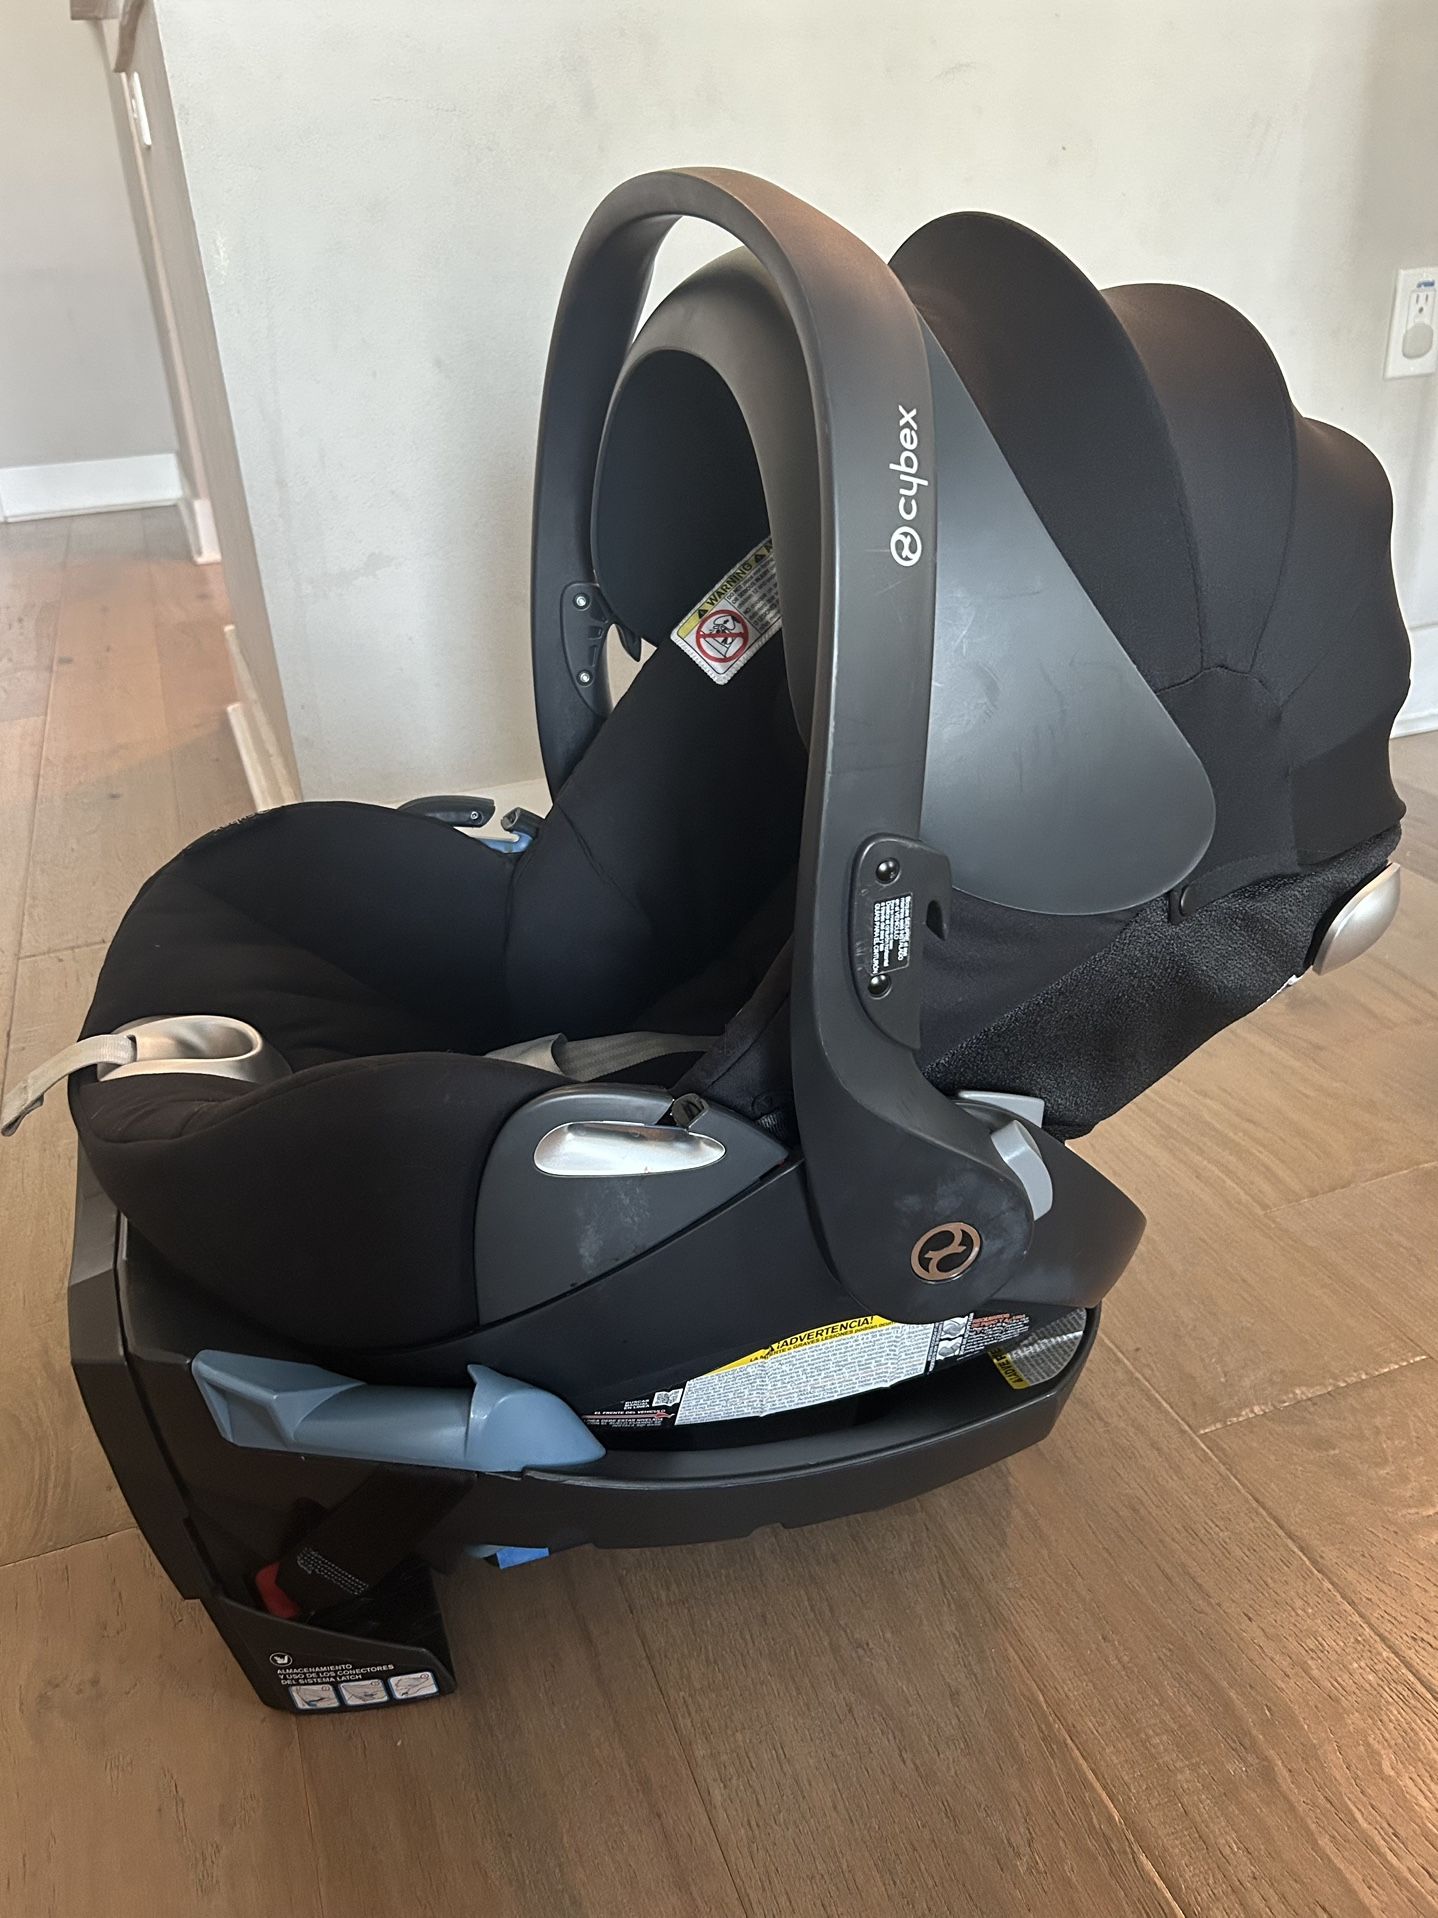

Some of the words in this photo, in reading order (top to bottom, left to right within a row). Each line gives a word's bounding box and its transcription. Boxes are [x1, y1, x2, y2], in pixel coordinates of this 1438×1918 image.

[889, 404, 928, 520] cybex
[706, 562, 752, 606] WARNING
[777, 1316, 874, 1350] ¡ADVERTENCIA!
[277, 1664, 353, 1674] ALMACENAMIENTO
[336, 1674, 362, 1682] LATCH
[337, 1664, 395, 1676] CONECTORES
